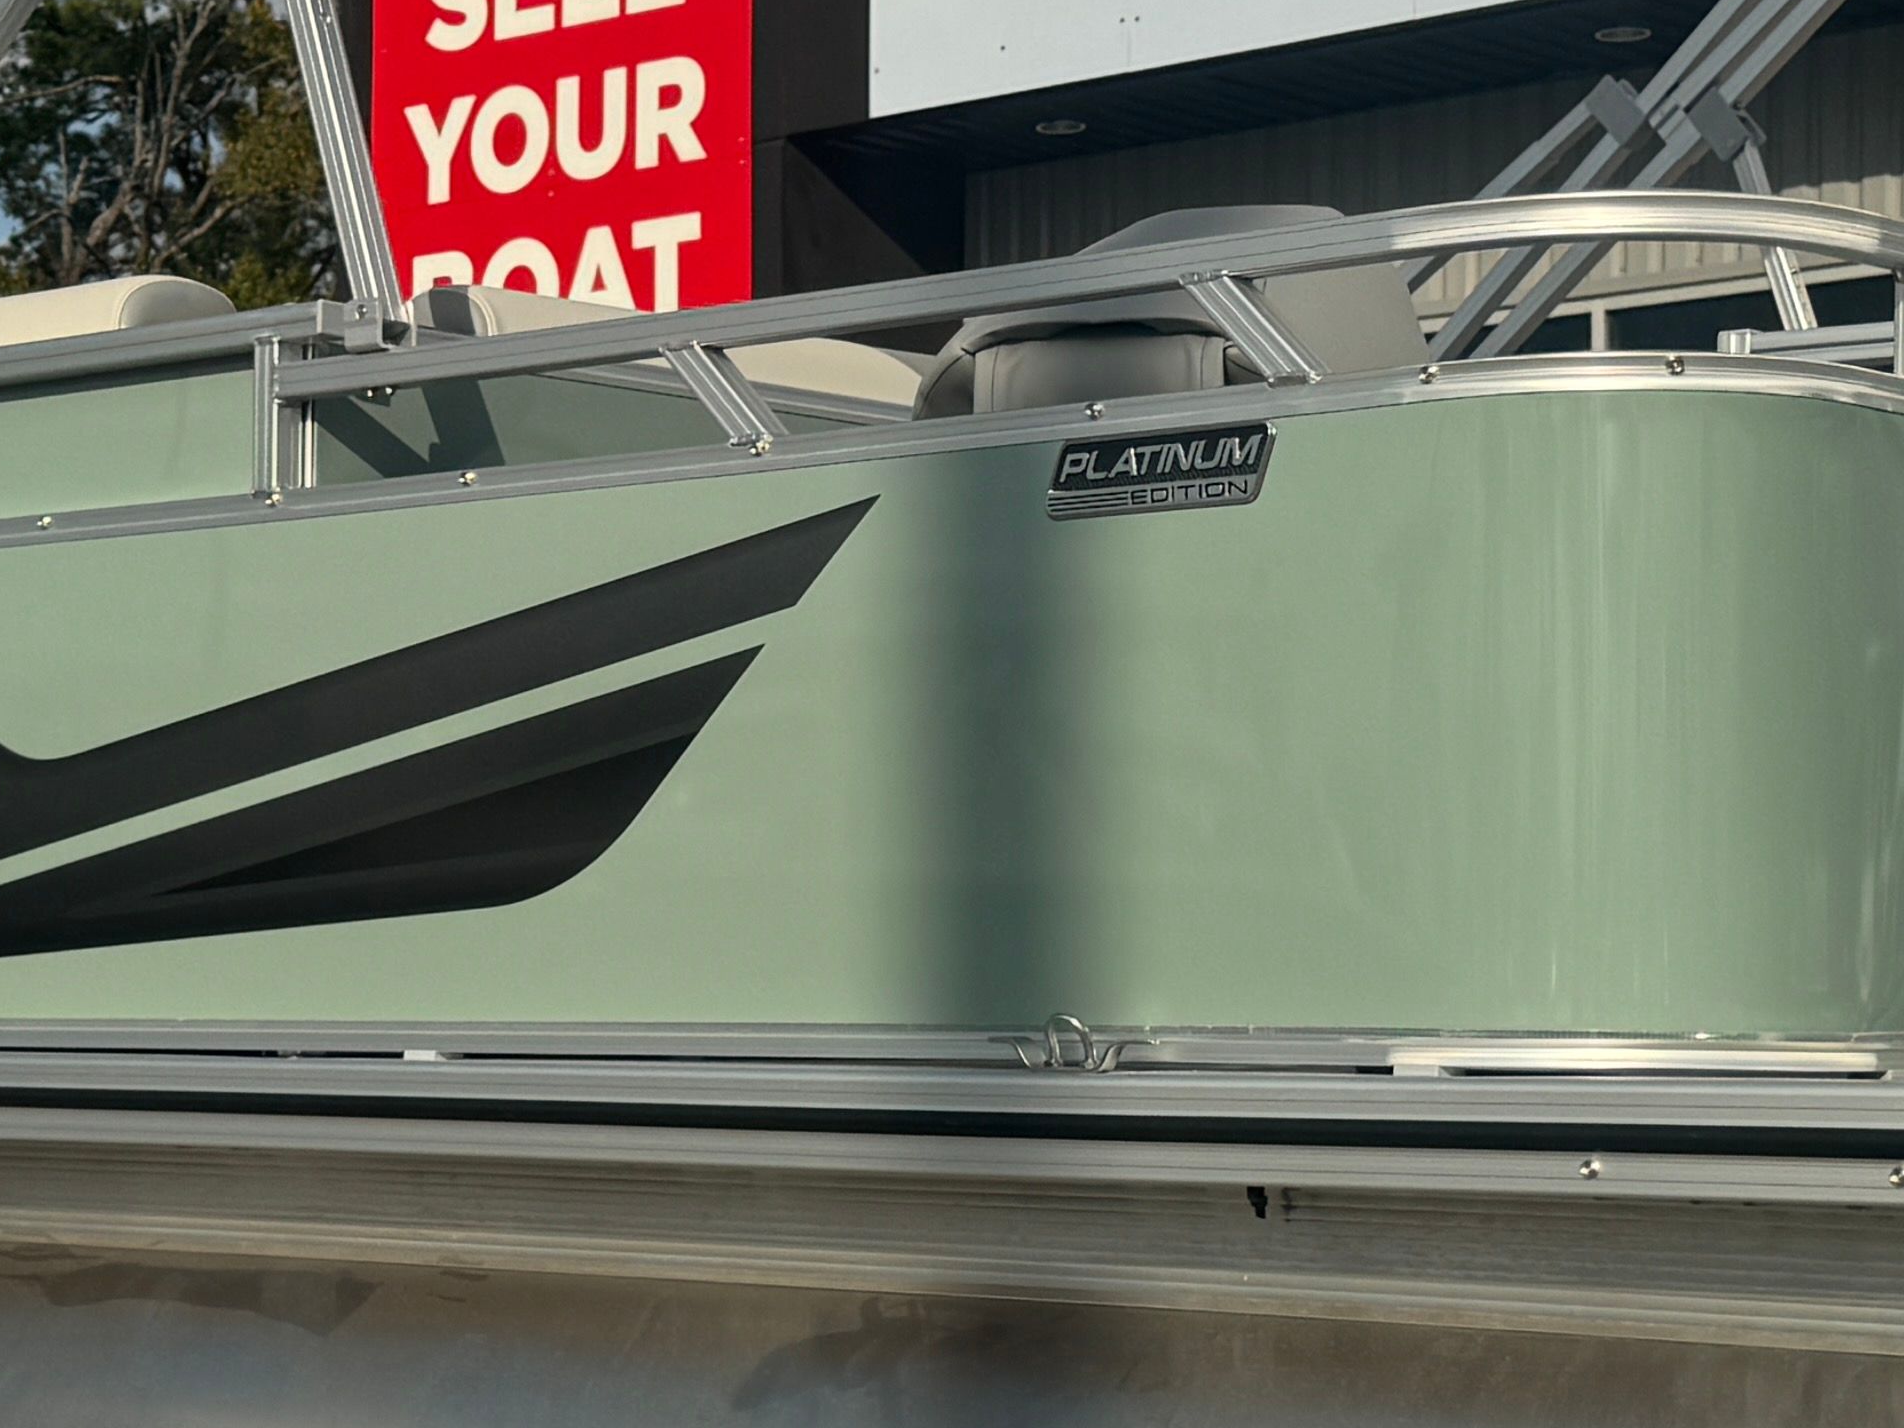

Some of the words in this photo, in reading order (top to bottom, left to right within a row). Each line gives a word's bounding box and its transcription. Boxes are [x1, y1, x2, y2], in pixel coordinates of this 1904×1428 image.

[403, 56, 707, 205] YOUR
[1059, 433, 1264, 483] PLATINUM
[1130, 479, 1248, 506] EDITION
